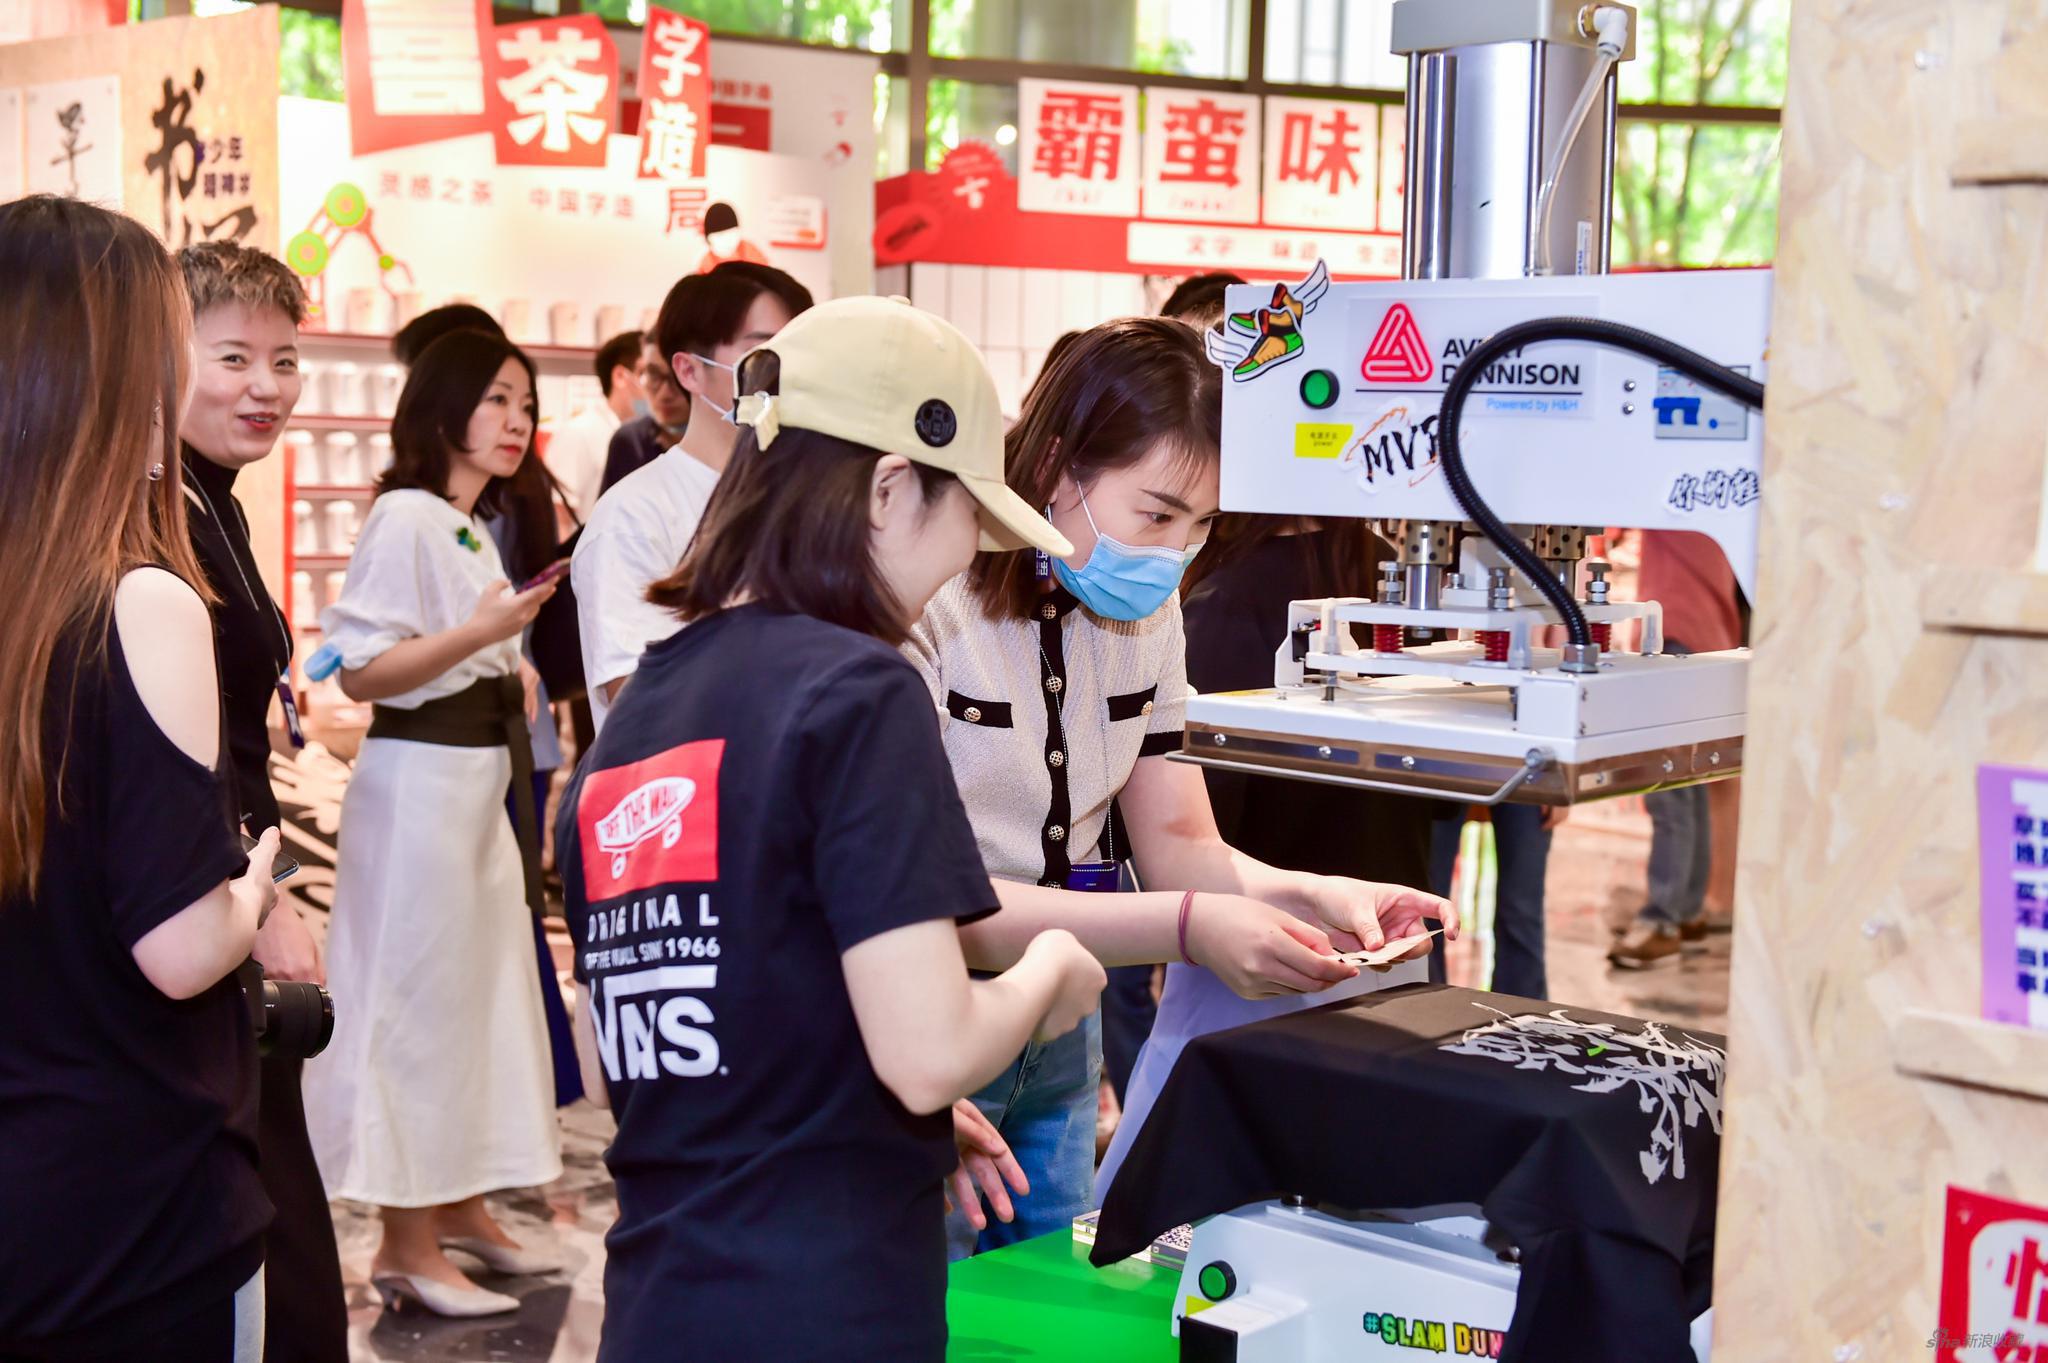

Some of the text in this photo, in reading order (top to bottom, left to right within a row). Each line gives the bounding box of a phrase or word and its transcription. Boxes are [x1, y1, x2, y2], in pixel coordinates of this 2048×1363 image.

[498, 28, 608, 151] 茶
[1032, 89, 1403, 195] 霸蛮味
[1443, 338, 1526, 359] AVY
[1442, 364, 1579, 385] DNNISON
[1487, 398, 1533, 409] Powered
[1536, 399, 1549, 412] by
[624, 791, 647, 836] THE
[665, 936, 721, 959] 1966
[1363, 1311, 1447, 1354] #SLAM
